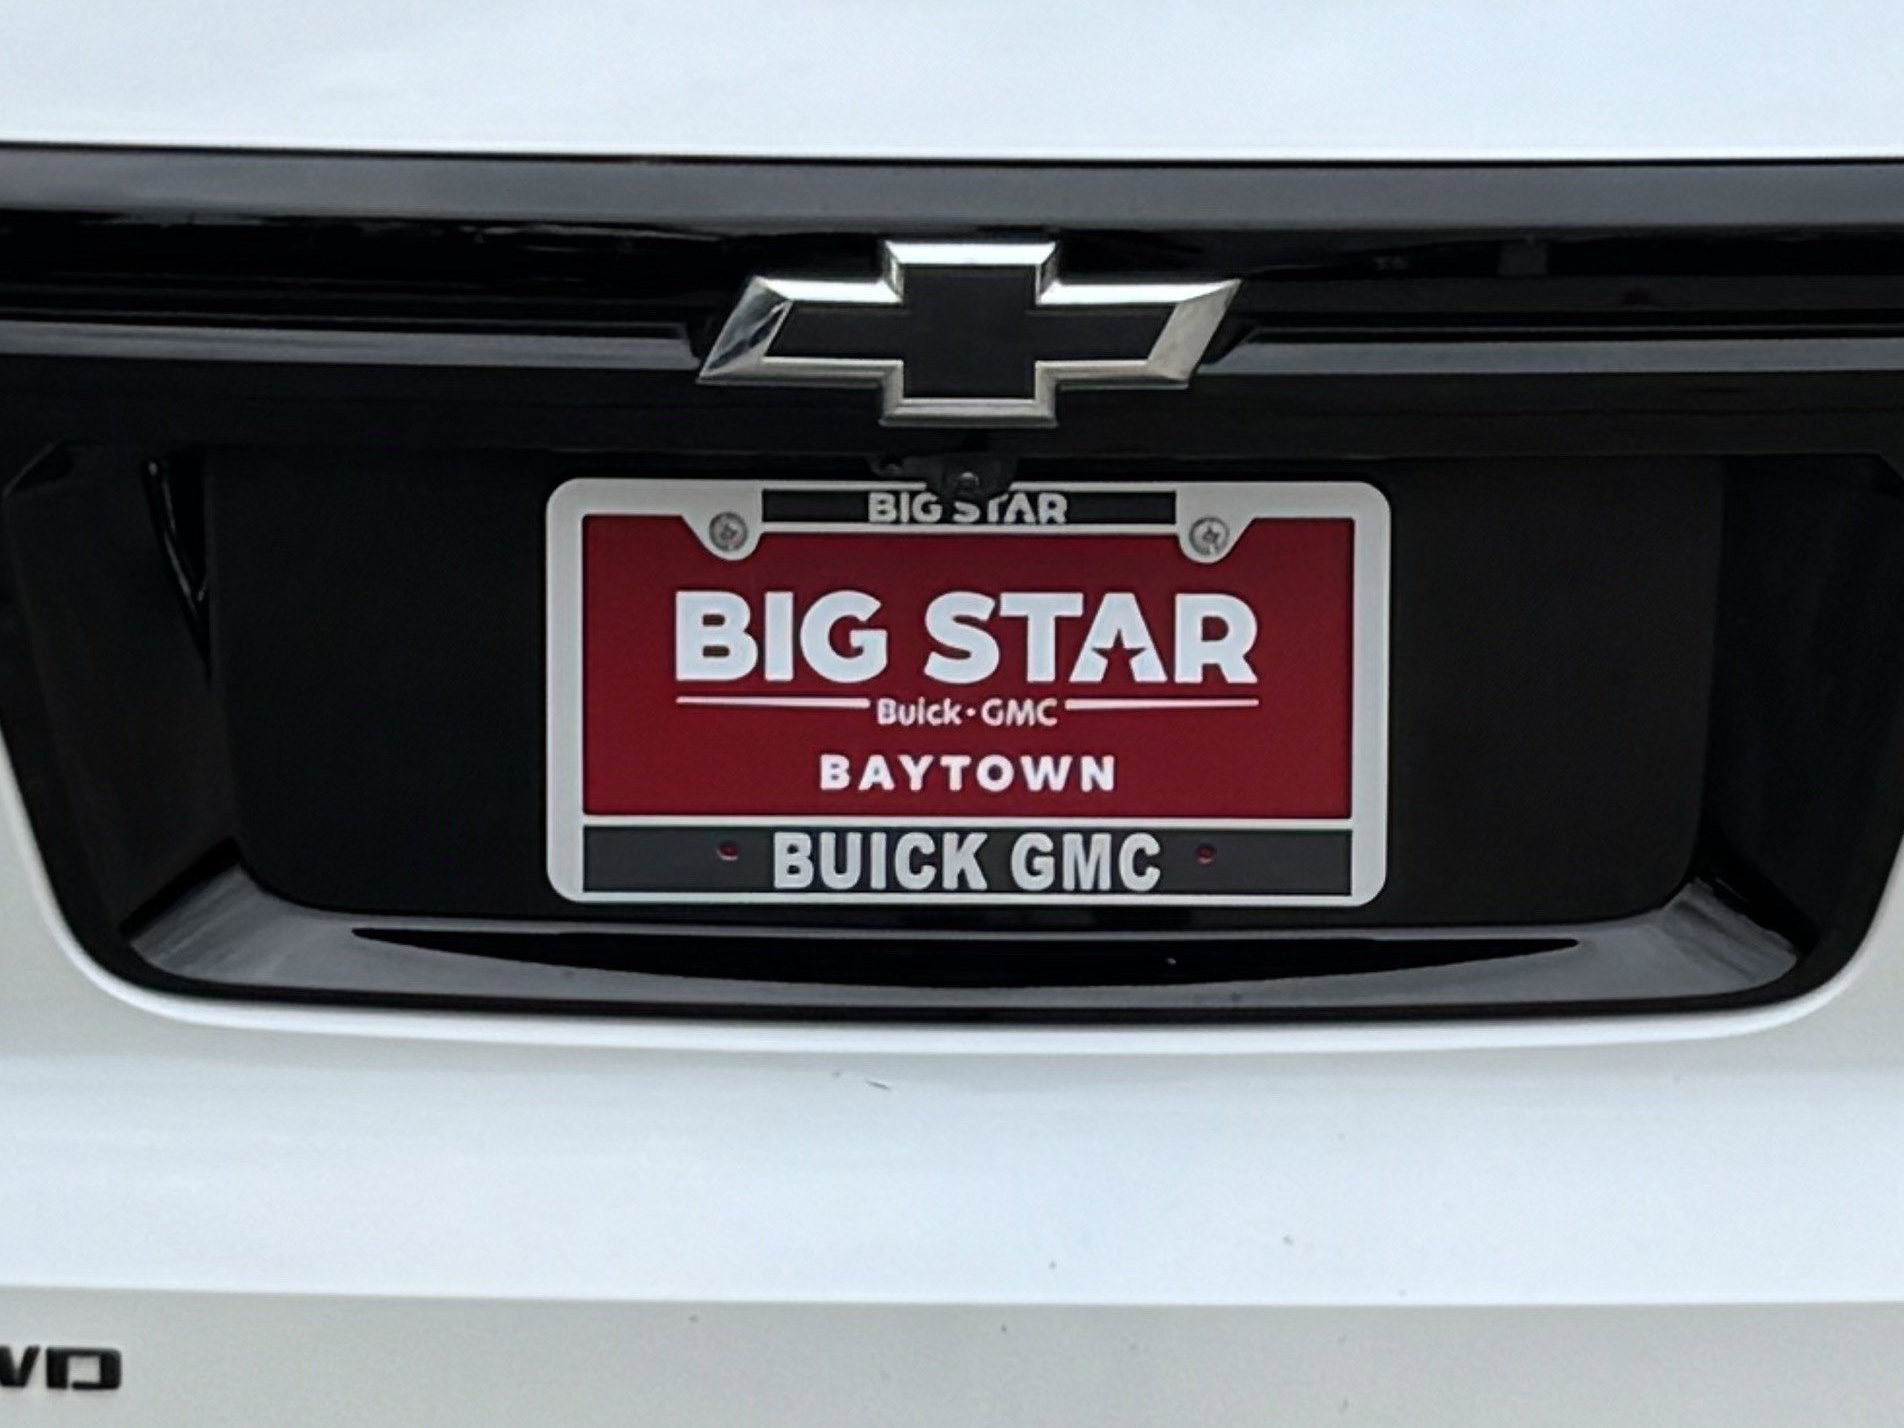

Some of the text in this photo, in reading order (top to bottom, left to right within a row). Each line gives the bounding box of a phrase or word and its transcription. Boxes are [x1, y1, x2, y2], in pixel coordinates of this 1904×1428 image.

[868, 491, 943, 523] BIG
[676, 590, 1258, 685] BIG STAR
[877, 696, 1058, 727] Buick GMC
[820, 754, 1115, 793] BAYTOWN
[773, 831, 1161, 892] BUICK GMC
